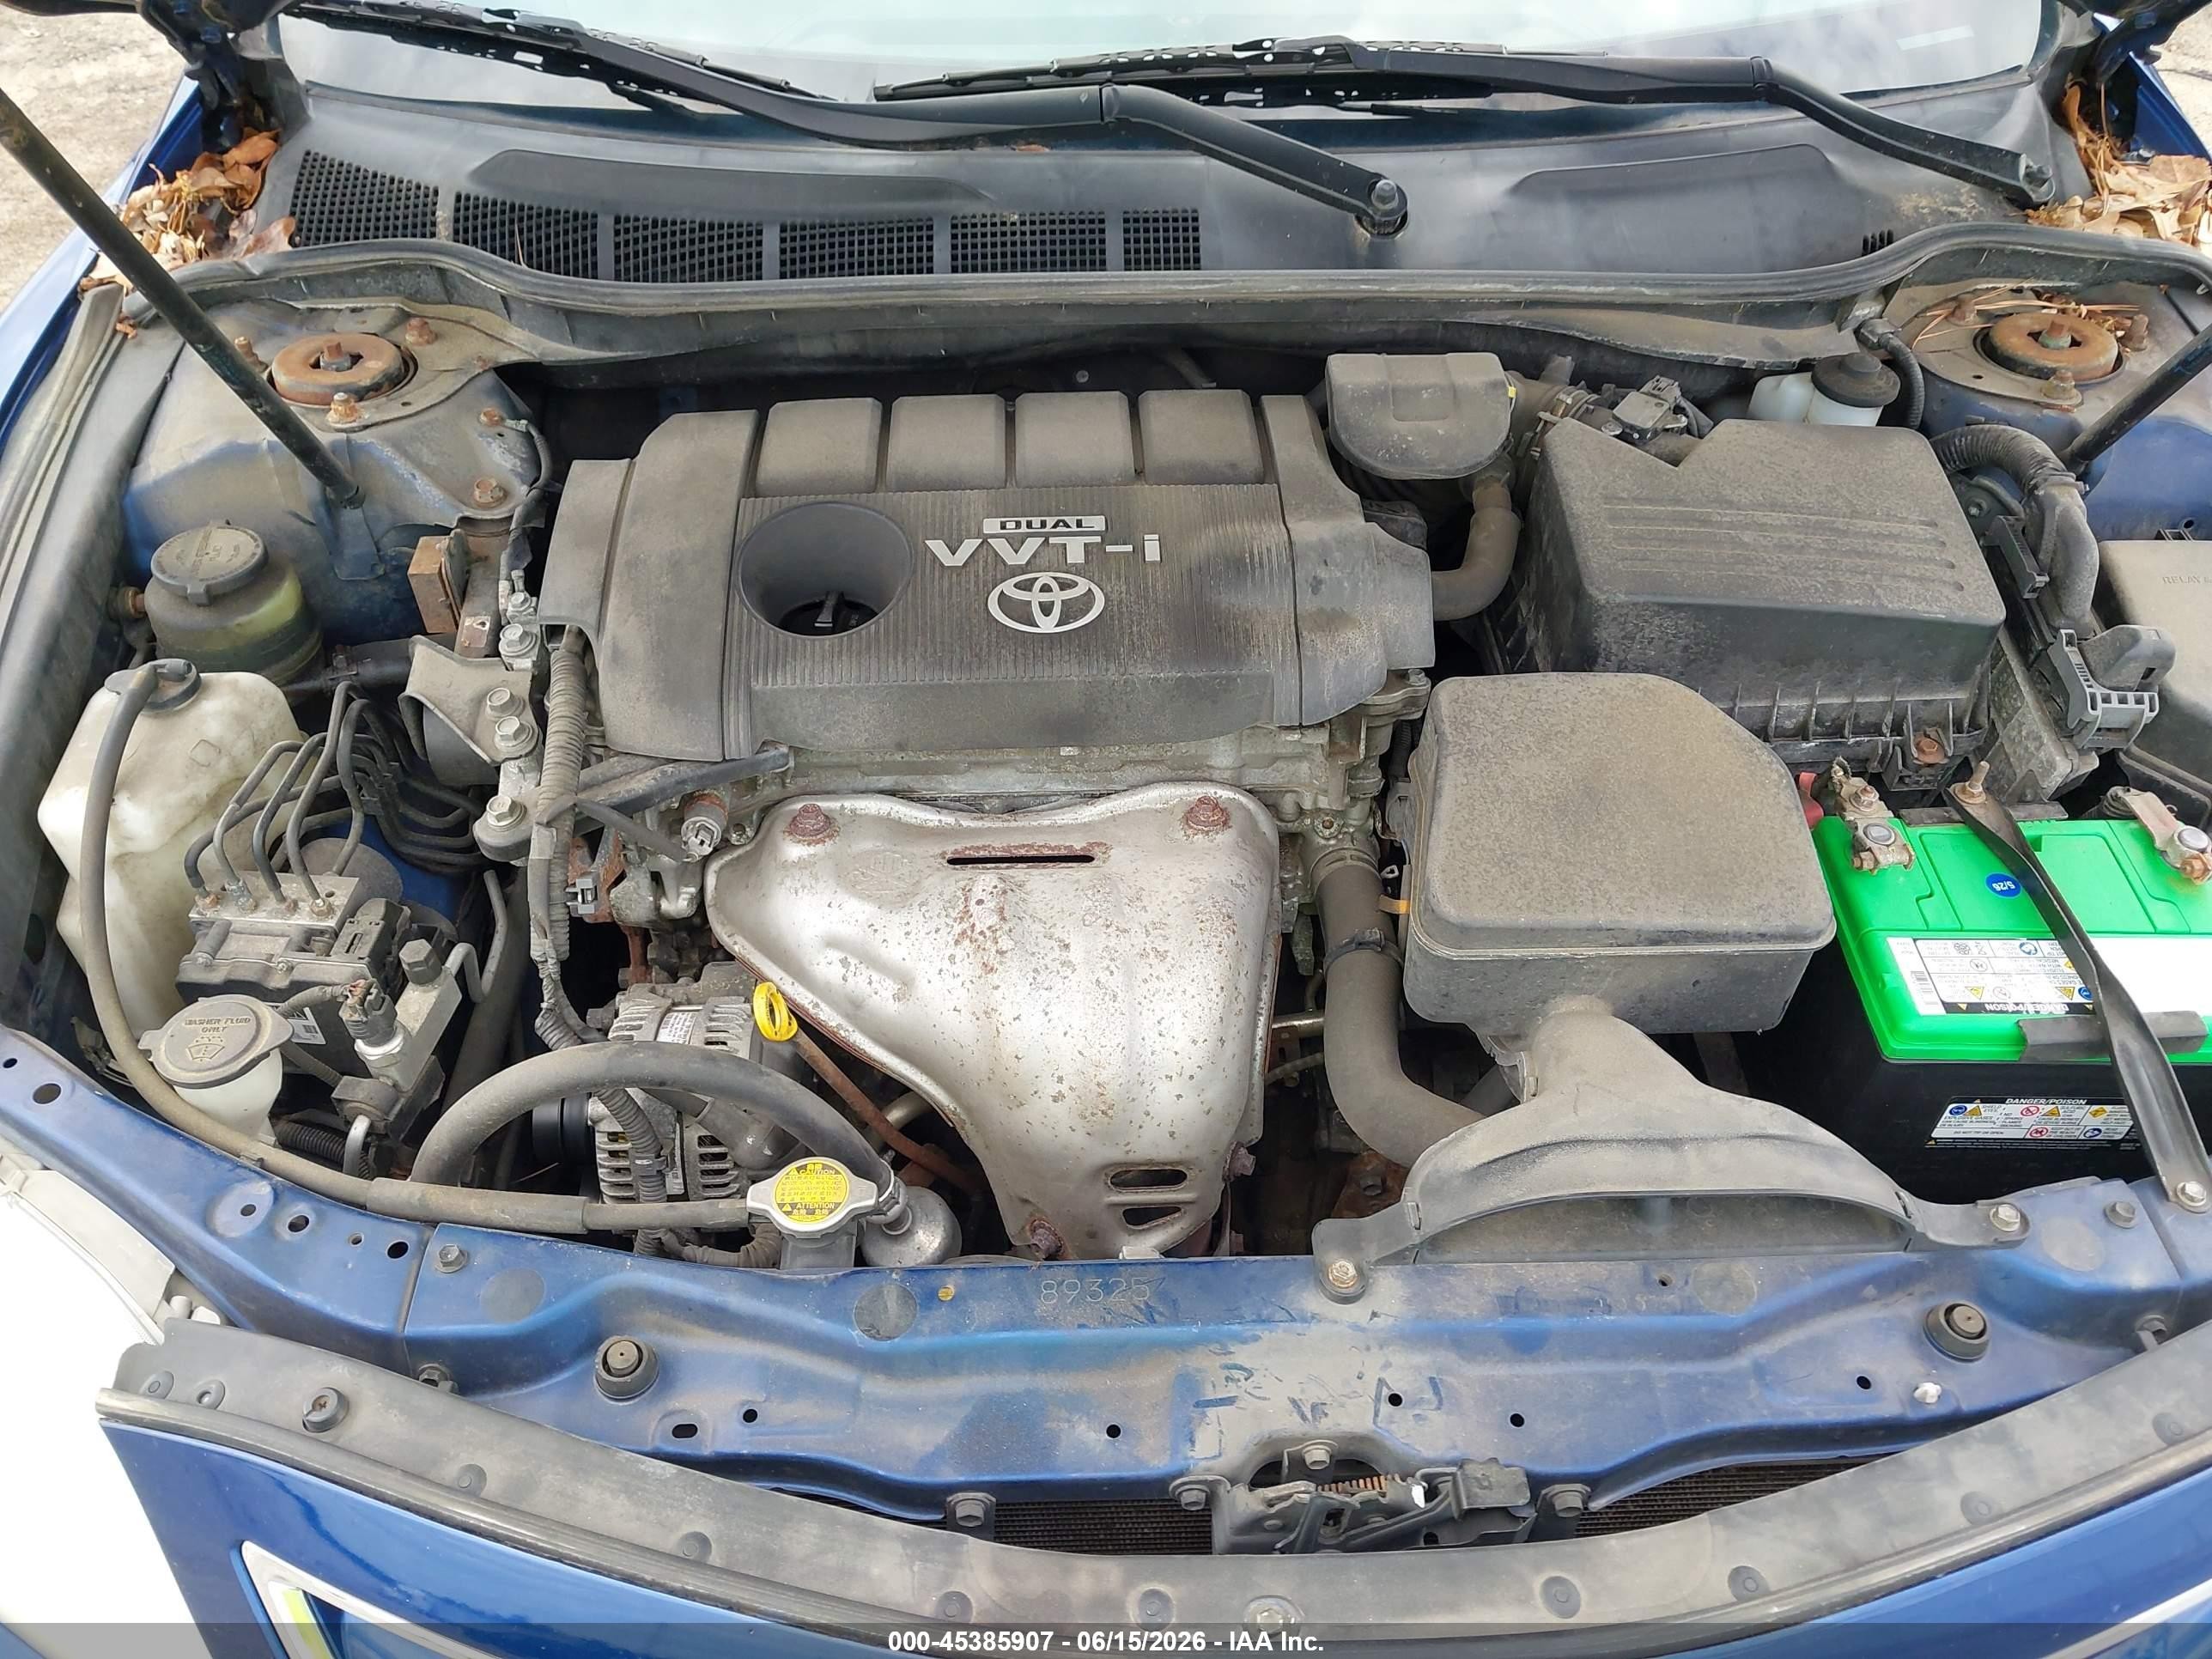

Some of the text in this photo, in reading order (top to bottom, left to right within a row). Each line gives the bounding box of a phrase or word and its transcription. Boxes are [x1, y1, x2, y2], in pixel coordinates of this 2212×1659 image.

[1000, 518, 1096, 530] DUAL
[924, 533, 1161, 567] VVT-i
[1991, 880, 2016, 891] 5/26
[184, 1018, 221, 1026] WASHER
[1040, 1277, 1150, 1304] 89325
